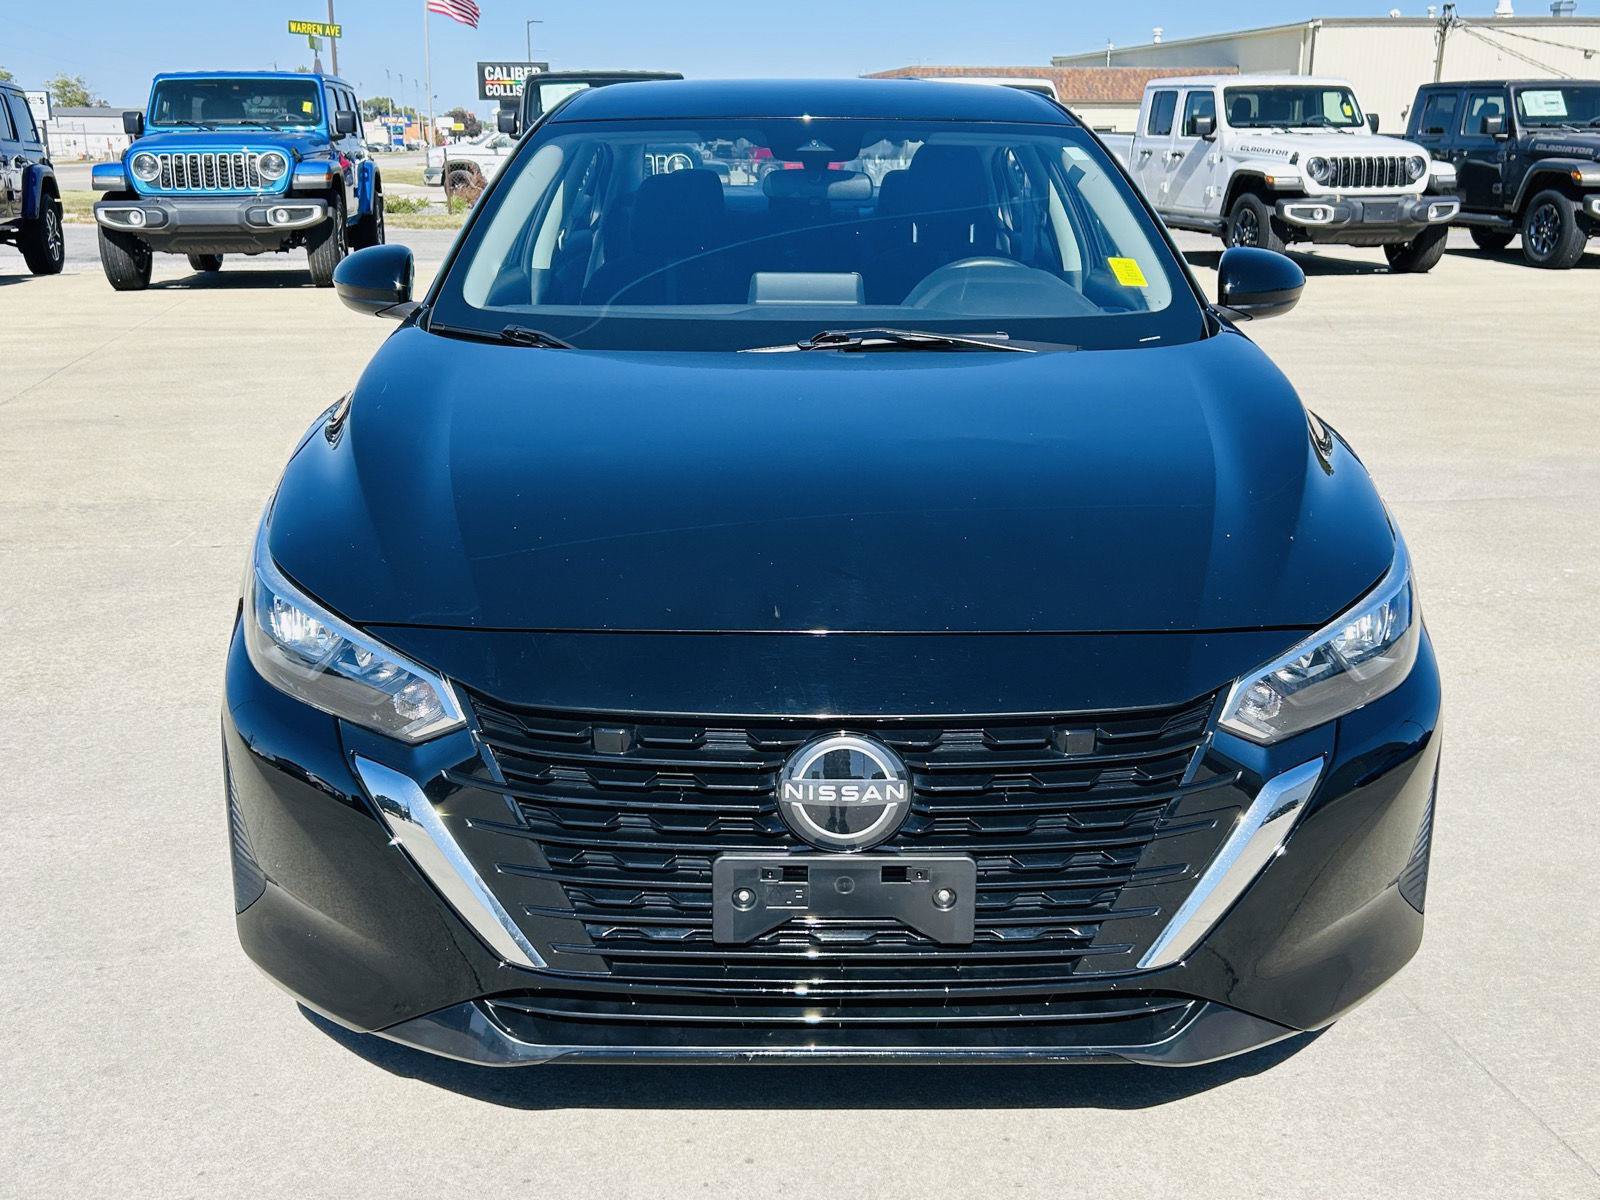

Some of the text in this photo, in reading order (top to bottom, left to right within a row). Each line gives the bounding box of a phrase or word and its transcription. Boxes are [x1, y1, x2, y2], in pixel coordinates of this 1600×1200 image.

[290, 21, 341, 37] WARREN AVE
[1240, 145, 1289, 156] GLADIATOR
[1535, 143, 1594, 155] GLADIATOR
[784, 783, 905, 803] NISSAN
